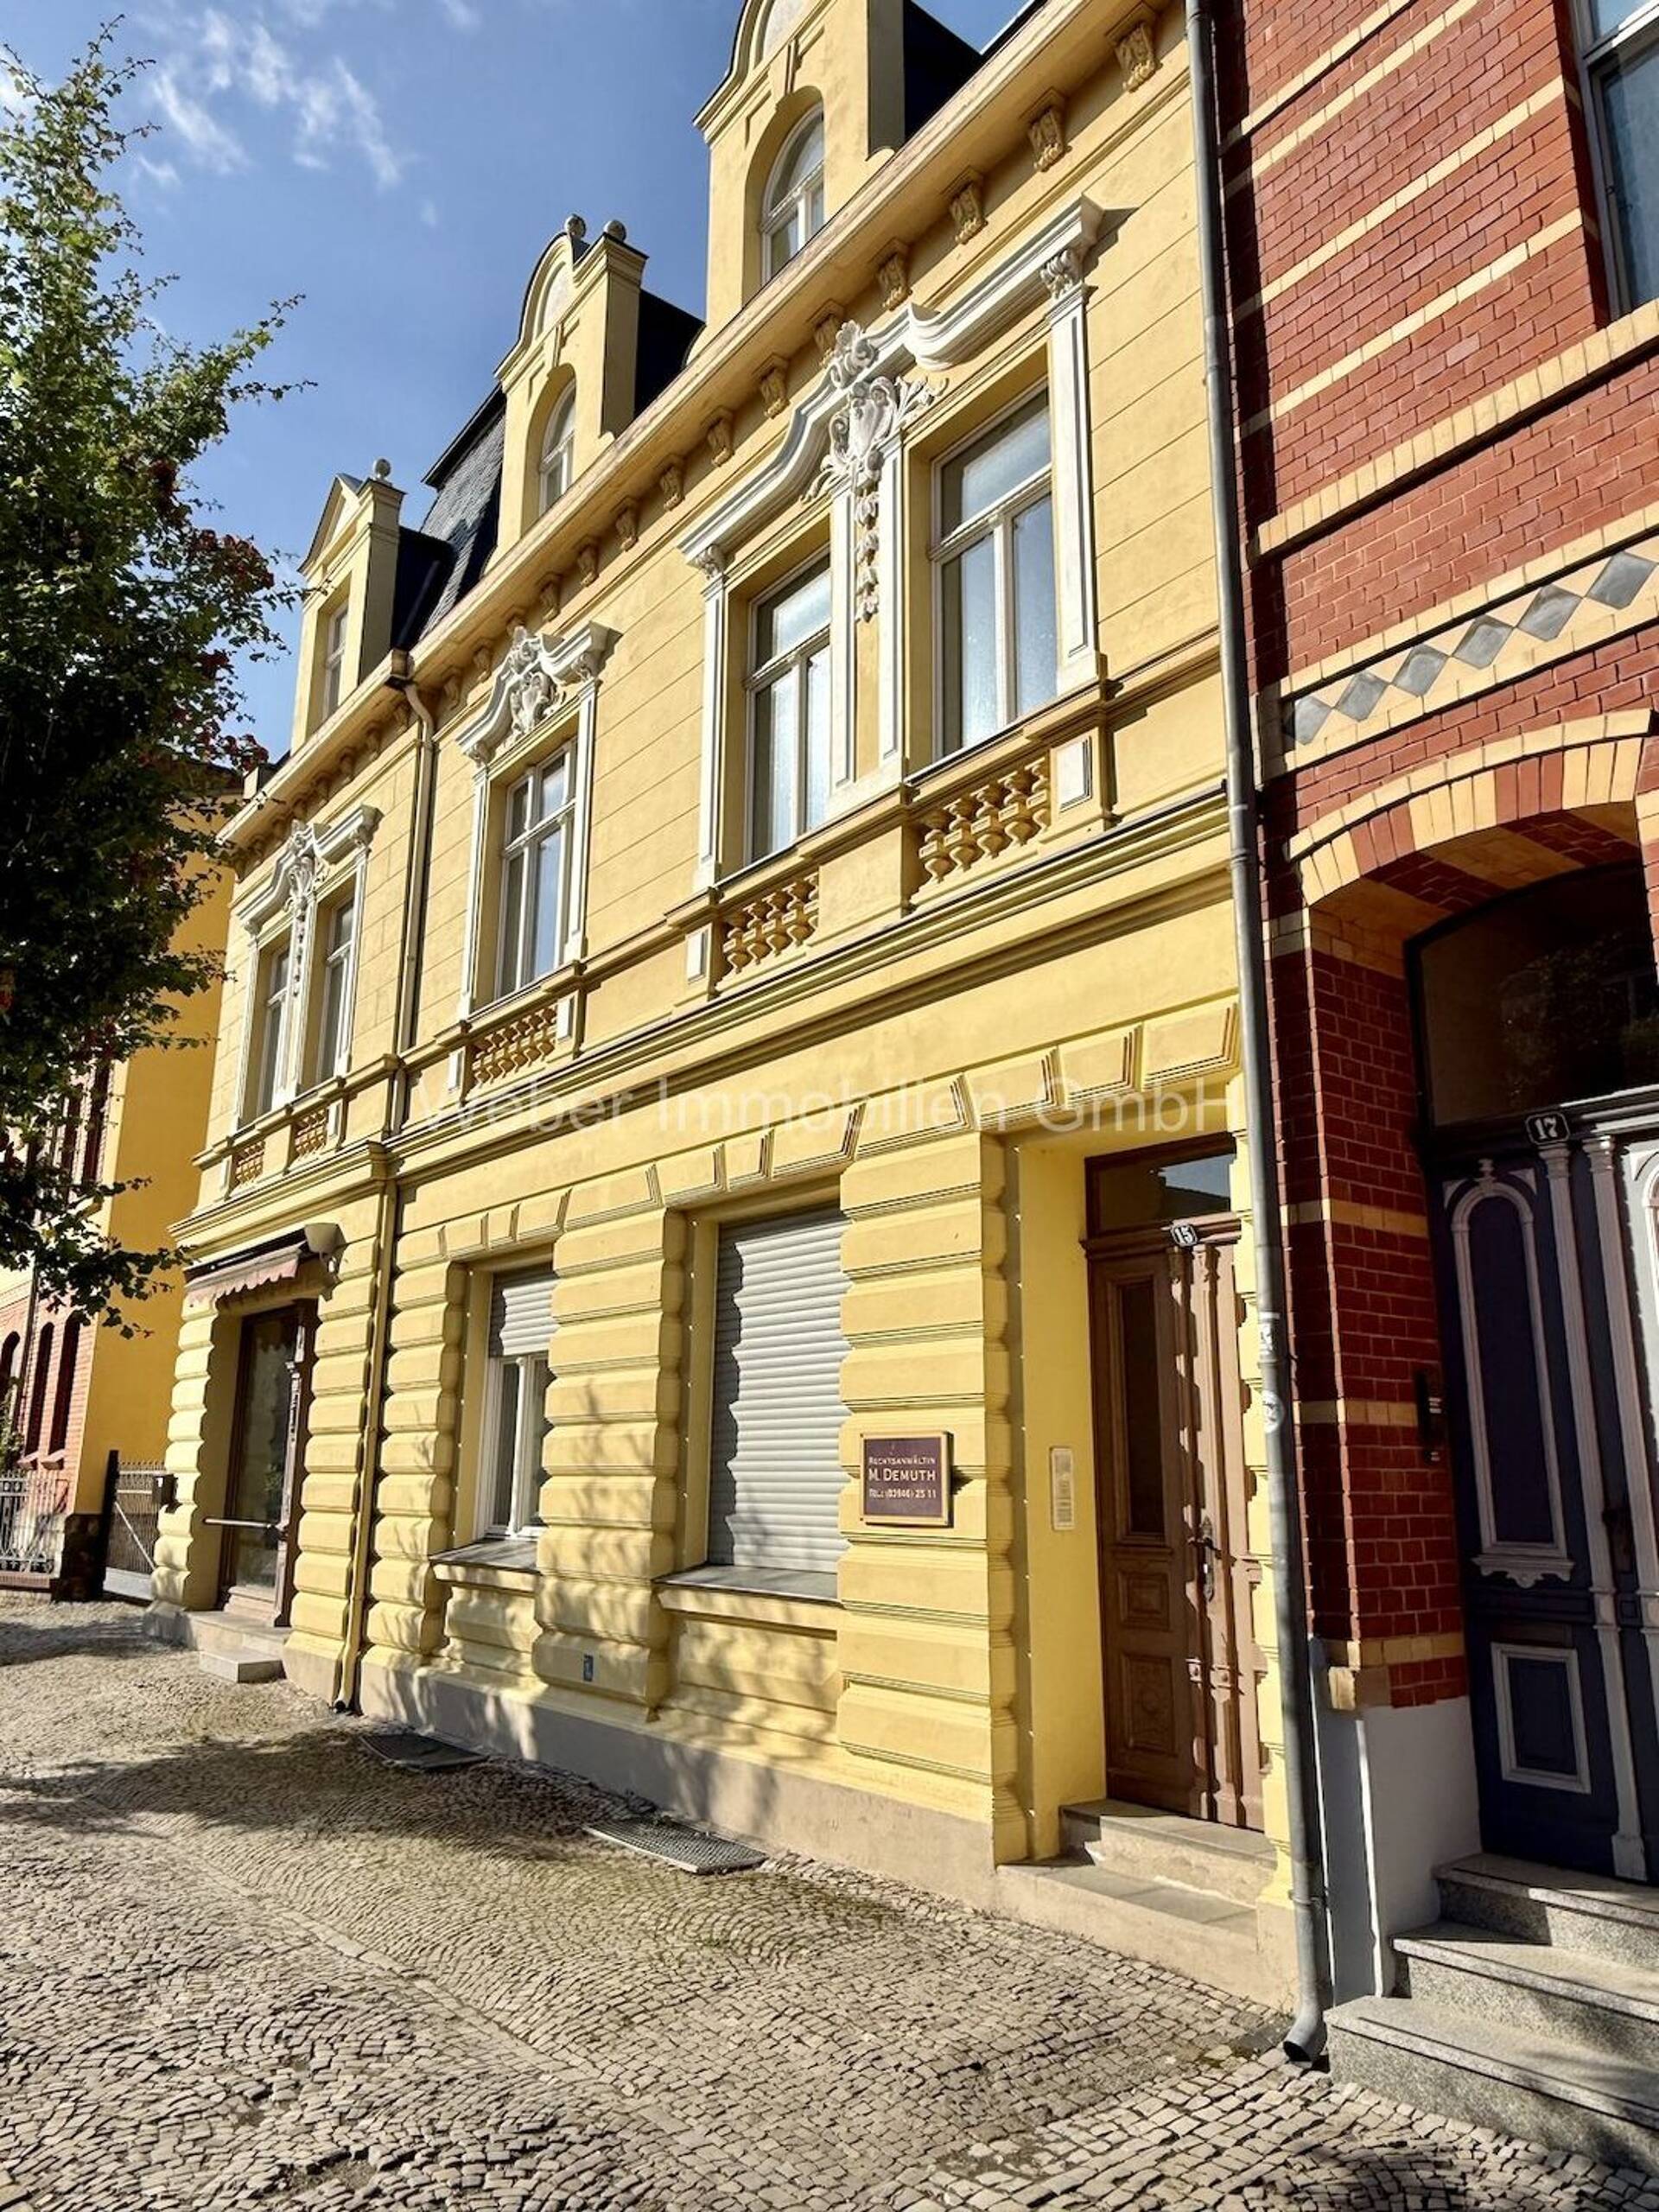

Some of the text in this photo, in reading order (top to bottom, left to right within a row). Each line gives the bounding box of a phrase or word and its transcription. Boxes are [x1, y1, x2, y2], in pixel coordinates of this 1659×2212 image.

[1535, 1116, 1559, 1140] 17
[1174, 1225, 1193, 1244] 15
[883, 1467, 936, 1482] DEMUTH
[928, 1489, 937, 1498] 11
